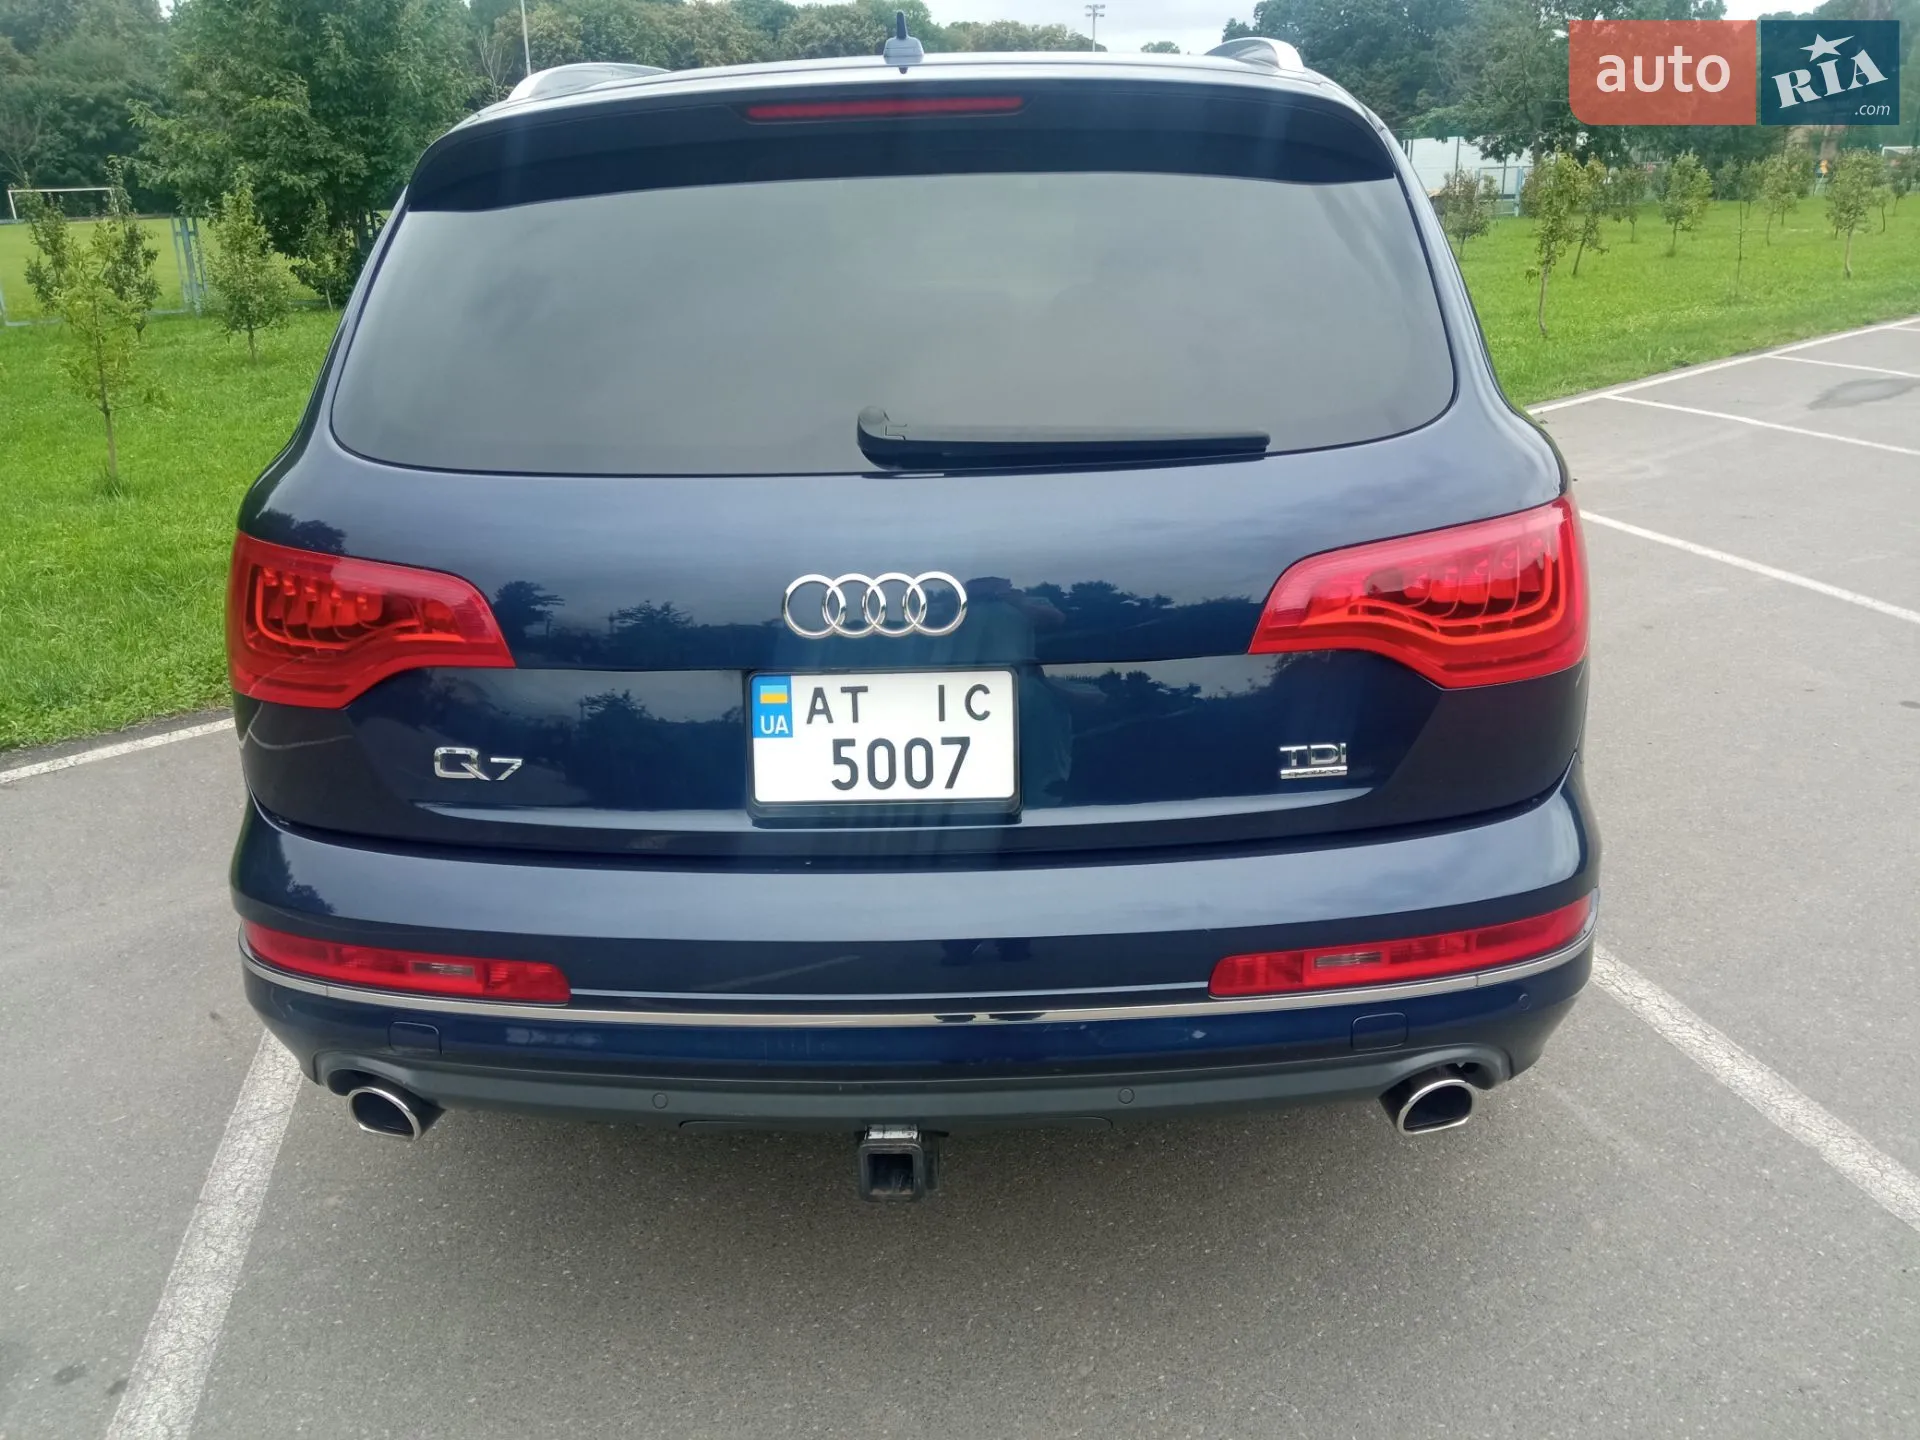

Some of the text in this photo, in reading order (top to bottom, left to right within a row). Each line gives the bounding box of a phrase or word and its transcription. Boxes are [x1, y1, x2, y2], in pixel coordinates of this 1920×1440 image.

[806, 683, 991, 725] AT IC
[760, 715, 789, 735] UA
[434, 746, 523, 781] Q7
[831, 736, 971, 791] 5007
[1279, 743, 1347, 767] TDI
